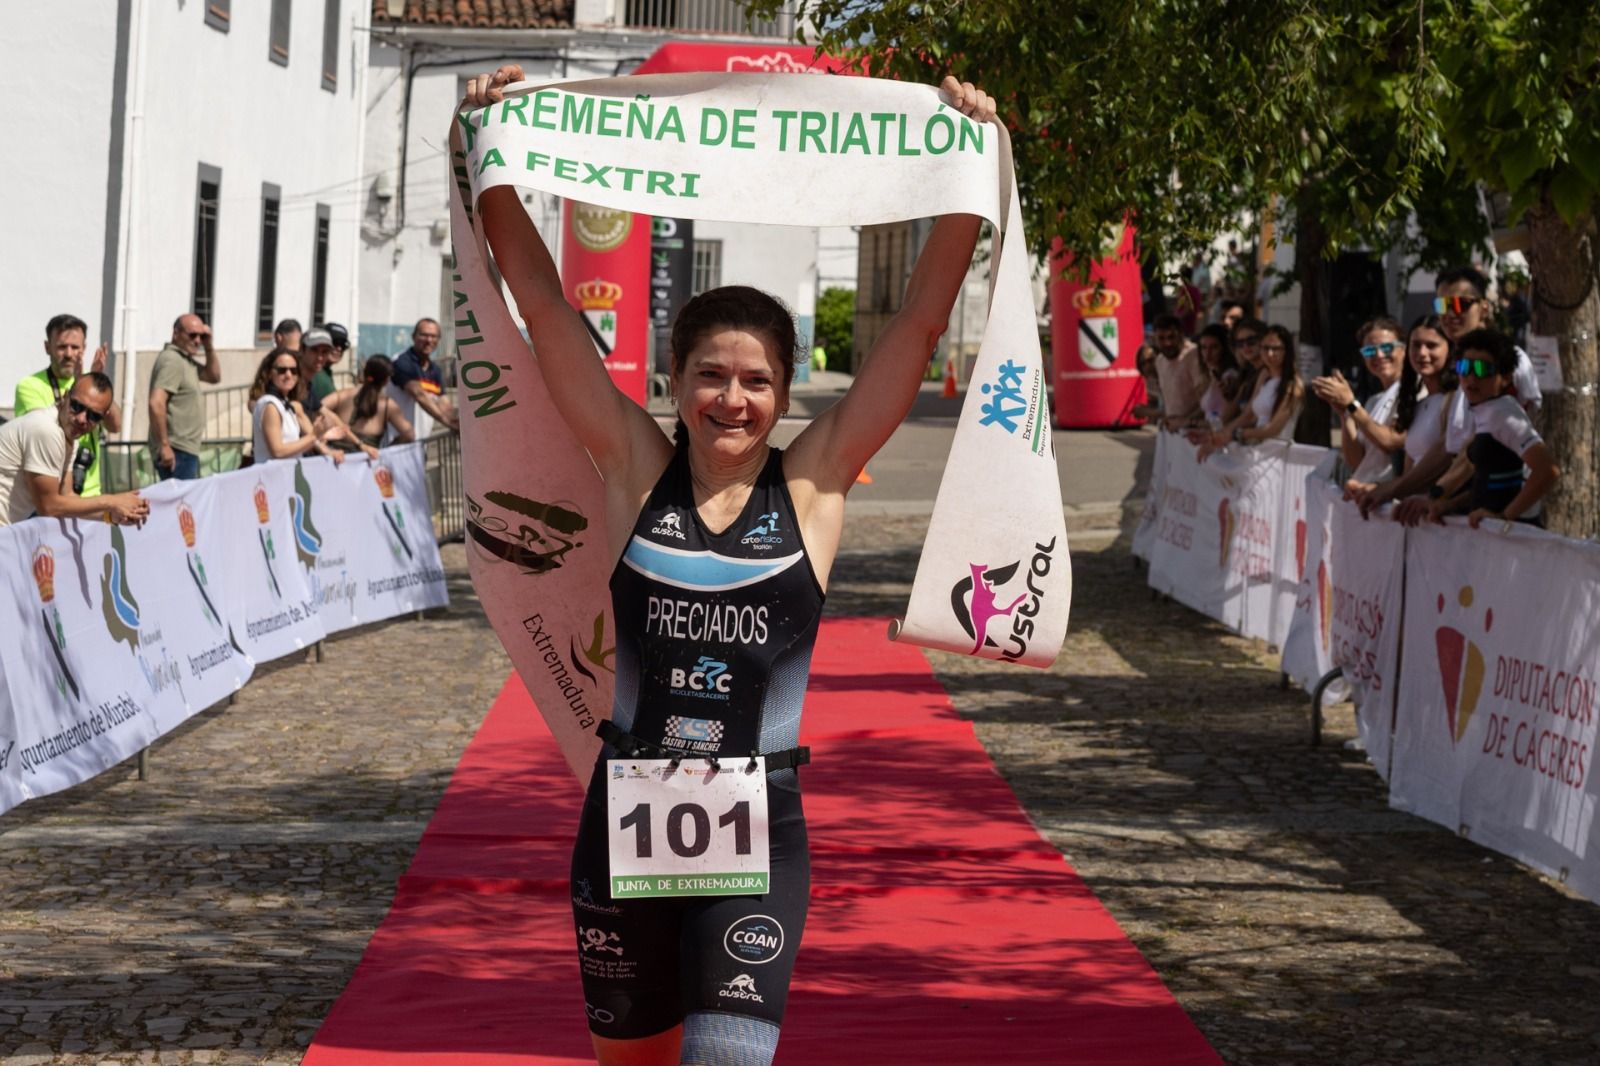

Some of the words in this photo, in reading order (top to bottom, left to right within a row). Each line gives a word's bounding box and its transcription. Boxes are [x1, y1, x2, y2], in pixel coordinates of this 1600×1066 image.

[701, 108, 758, 150] DE
[772, 104, 985, 157] TRIATLÓN
[526, 151, 701, 199] FEXTRI
[1023, 368, 1040, 441] Extremadura
[646, 596, 769, 645] PRECIADOS
[522, 612, 597, 730] Extremadura
[1493, 655, 1597, 727] DIPUTACIÓN
[89, 709, 106, 736] de
[661, 736, 687, 749] CASTRO
[686, 740, 693, 749] Y
[1483, 712, 1510, 759] DE
[1512, 713, 1587, 789] CÁCERES
[619, 800, 752, 858] 101
[617, 879, 651, 893] JUNTA
[657, 879, 672, 890] DE
[678, 877, 763, 890] EXTREMADURA
[732, 930, 778, 949] COAN
[718, 989, 764, 1003] austral
